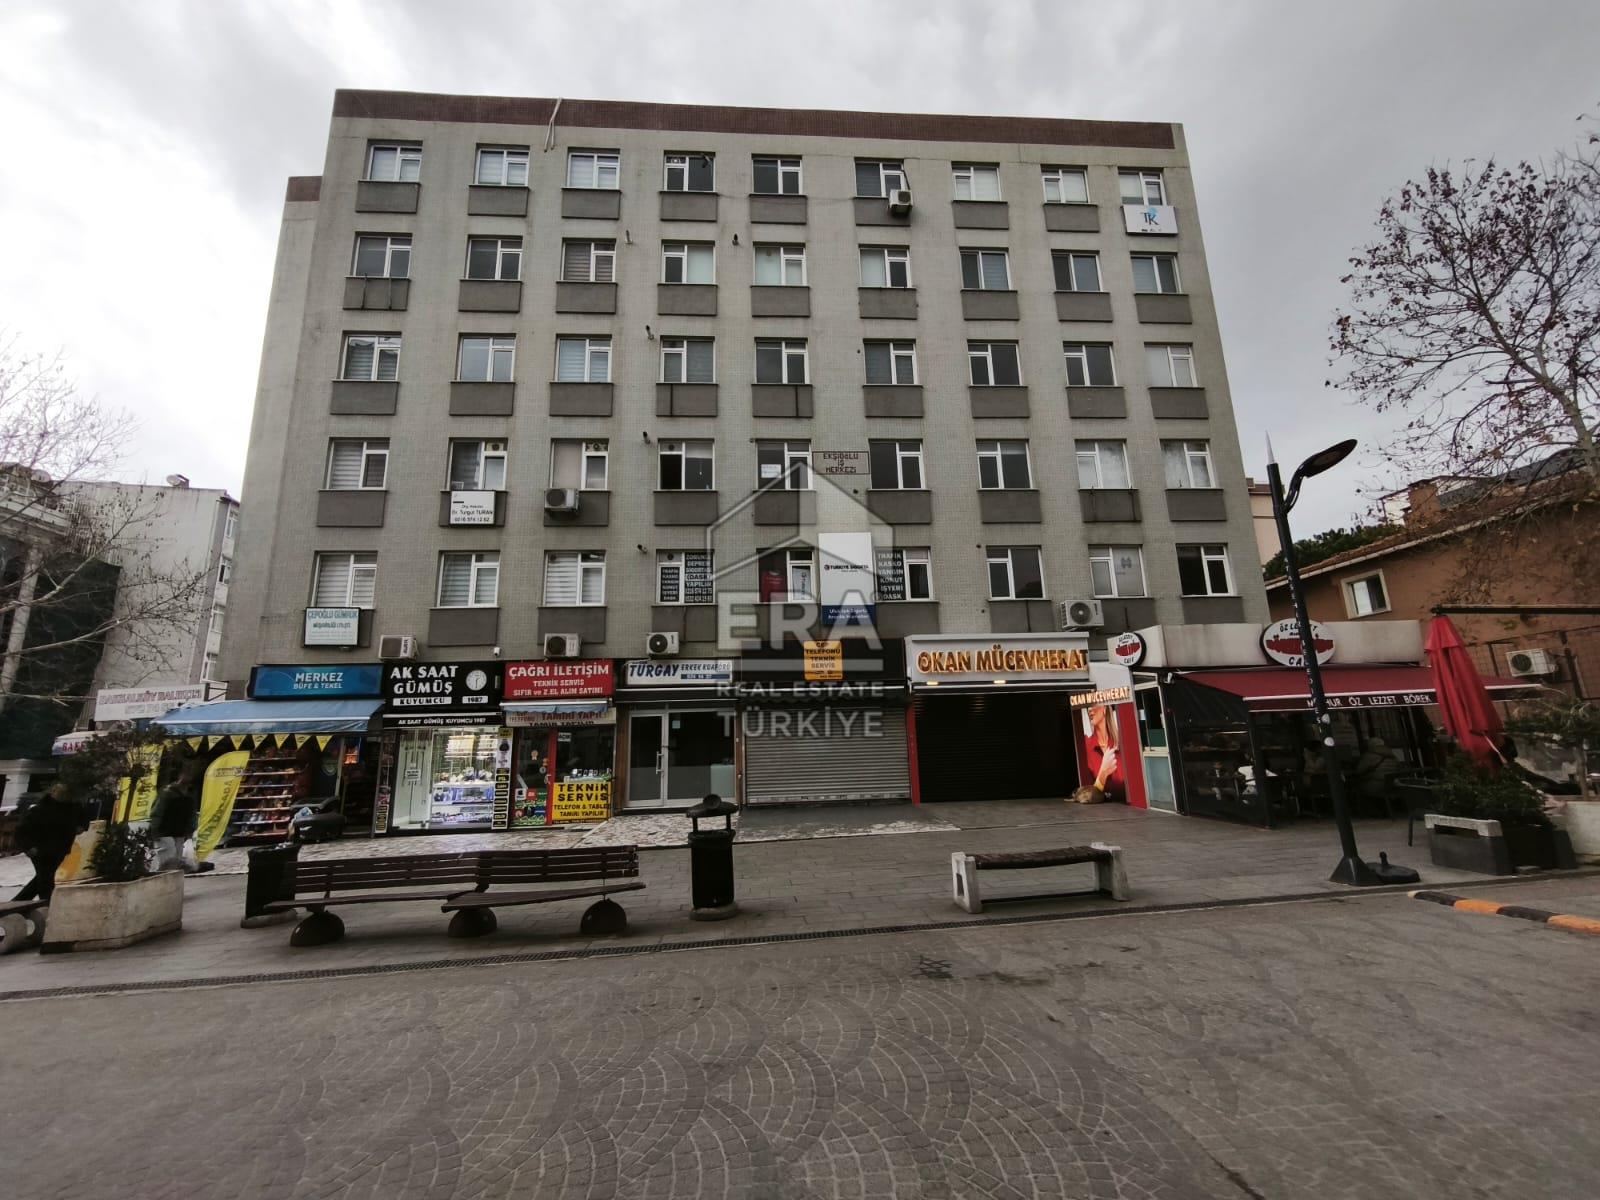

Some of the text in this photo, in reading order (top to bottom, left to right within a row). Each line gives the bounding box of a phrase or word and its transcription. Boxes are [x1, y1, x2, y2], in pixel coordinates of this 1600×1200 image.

[917, 644, 1088, 673] OKAN MÜCEVHERAT
[390, 665, 459, 679] AK SAAT
[508, 662, 609, 680] ÇAĞRI İLETİŞİM
[629, 663, 679, 677] TURGAY
[295, 672, 343, 682] MERKEZ
[393, 680, 453, 695] GÜMÜŞ
[400, 696, 445, 704] KUYUMCU
[1349, 696, 1363, 706] ÖZ
[1368, 696, 1397, 705] LEZZET
[557, 783, 608, 792] TEKNİK
[557, 793, 608, 801] SERVİS
